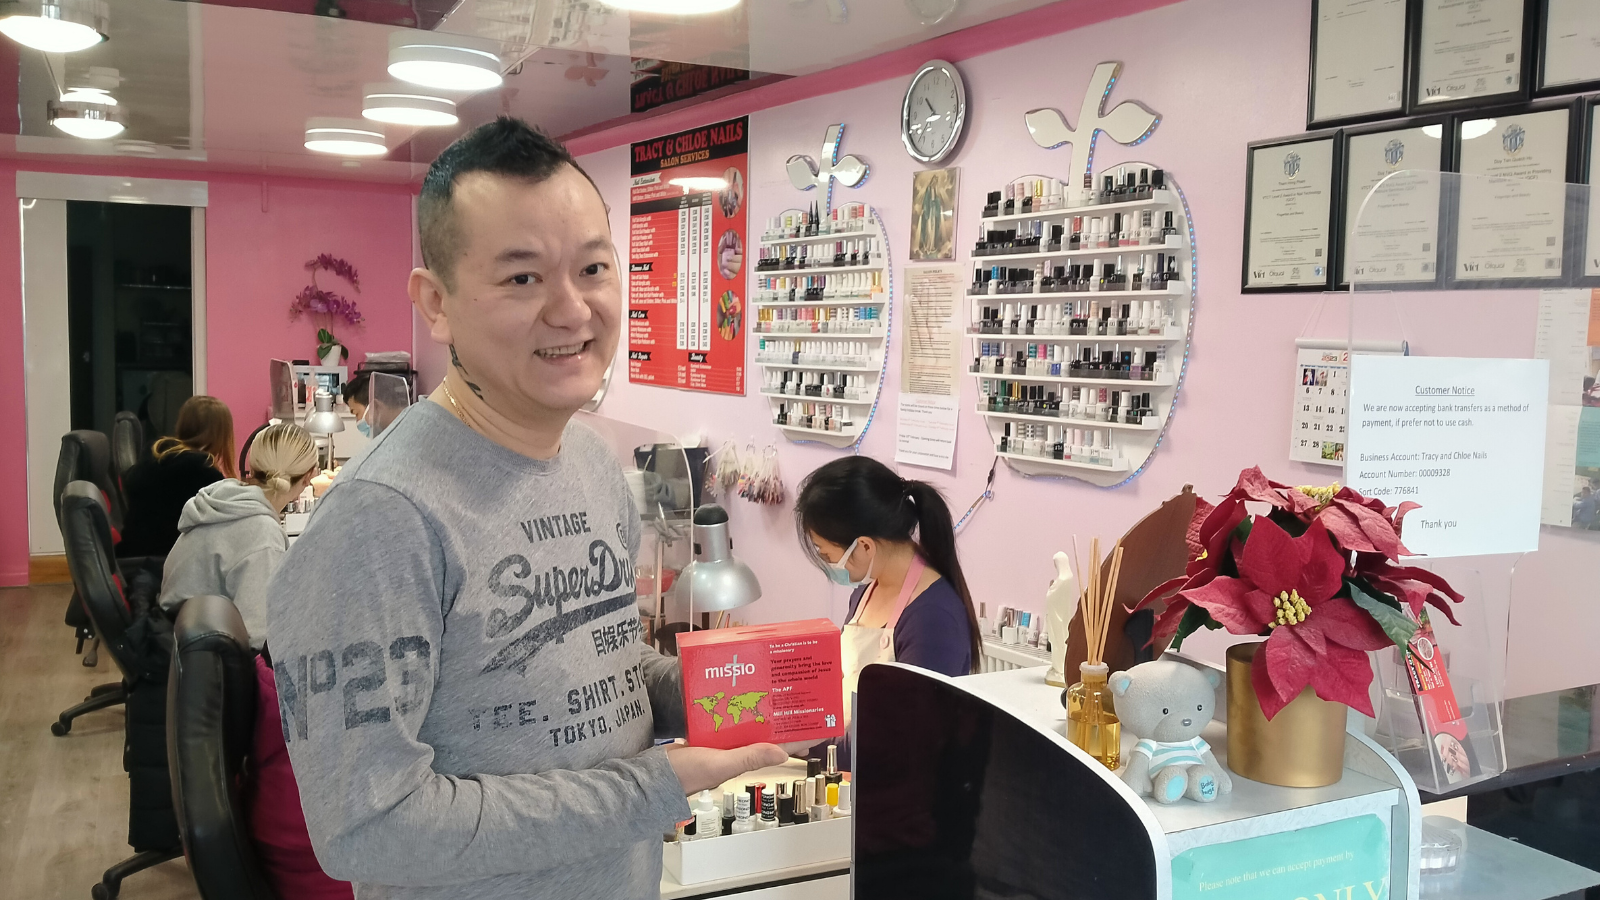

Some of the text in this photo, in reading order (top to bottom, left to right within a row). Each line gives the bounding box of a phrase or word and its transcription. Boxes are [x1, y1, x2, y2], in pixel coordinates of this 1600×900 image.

[933, 77, 940, 86] 12
[916, 97, 923, 105] 10
[634, 122, 743, 162] TRACY & CHLOE NAILS
[660, 150, 710, 168] SALON SERVICES
[1415, 385, 1475, 395] Customer Notice
[1363, 404, 1374, 412] We
[1405, 404, 1436, 414] accepting
[1437, 404, 1453, 412] bank
[1362, 419, 1393, 428] payment,
[1395, 419, 1400, 427] if
[1401, 419, 1422, 428] prefer
[1458, 418, 1474, 427] cash.
[1360, 451, 1487, 462] Business Account: Tracy and Chloe Nails
[1359, 469, 1450, 479] Account Number: 00009328
[1358, 486, 1419, 496] Sort Code: 776841
[520, 512, 591, 544] VINTAGE
[1421, 520, 1457, 530] Thank you
[468, 700, 549, 732] TEE.
[567, 676, 624, 715] SHIRT.
[550, 699, 645, 746] TOKYO, JAPAN.
[1200, 851, 1354, 891] Please note that we can accept payment by
